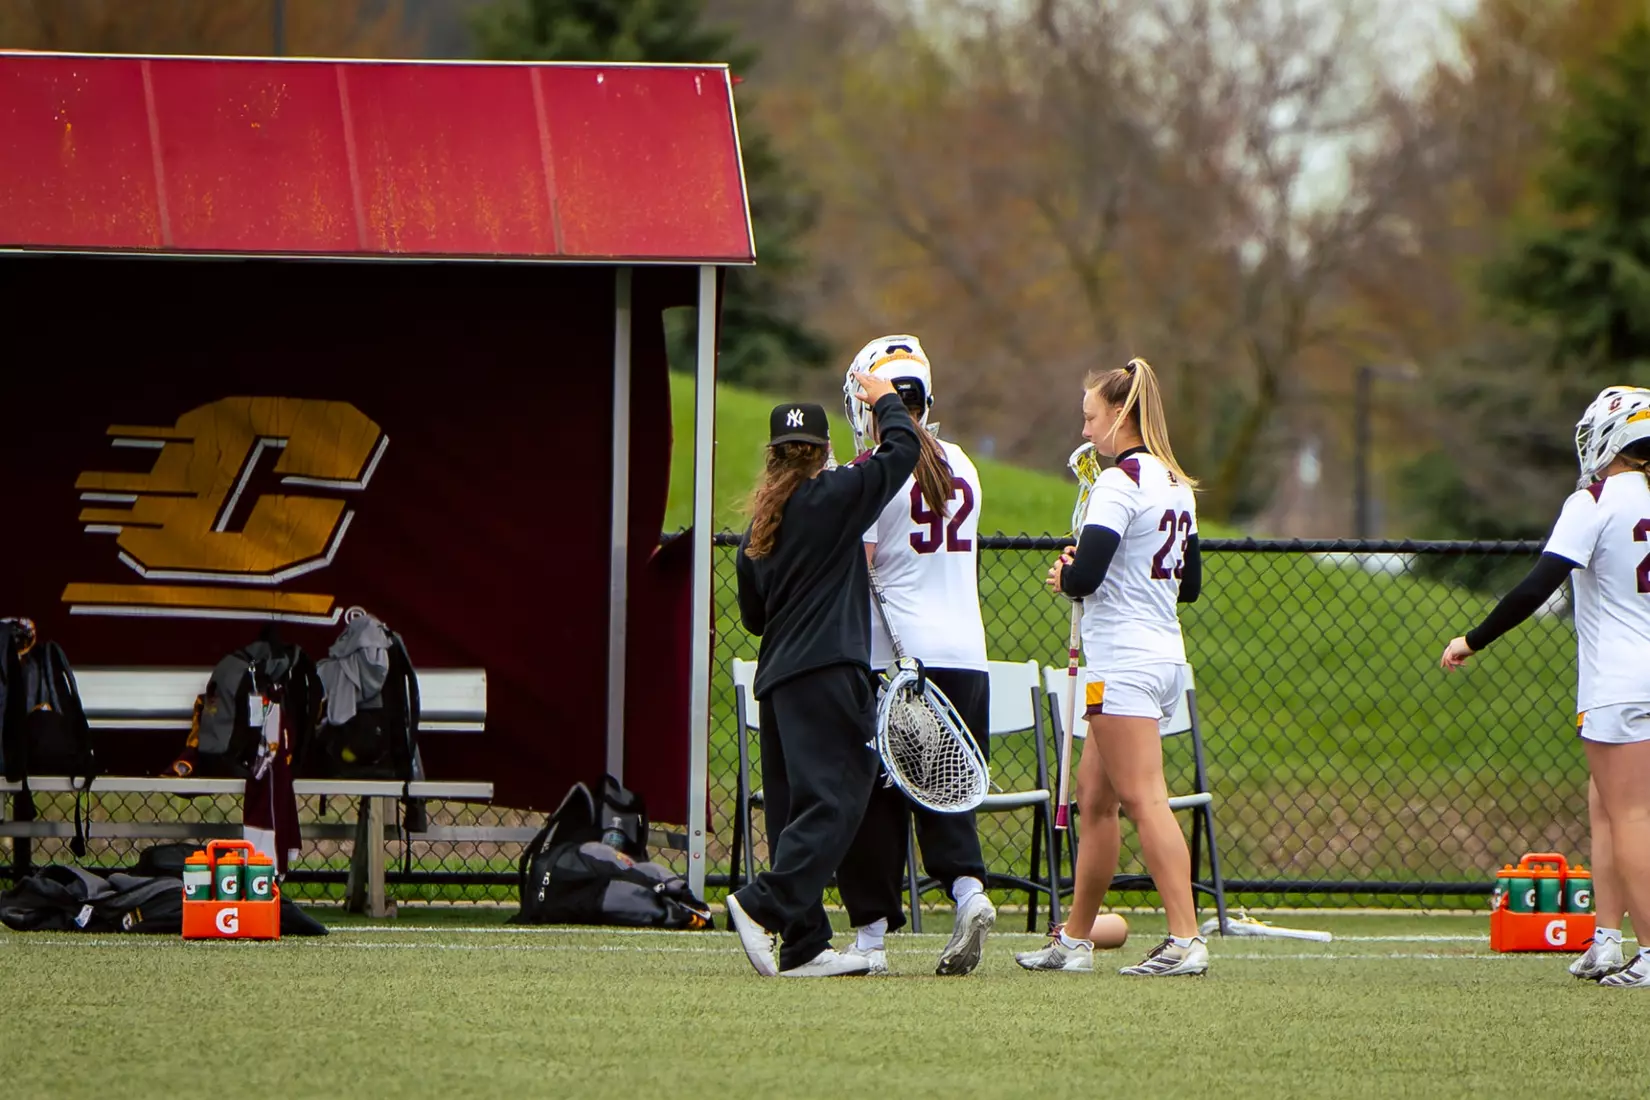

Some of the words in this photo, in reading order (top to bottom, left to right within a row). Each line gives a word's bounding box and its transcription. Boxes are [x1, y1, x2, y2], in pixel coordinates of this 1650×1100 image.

[786, 408, 804, 427] NY
[75, 396, 389, 584] C
[909, 477, 974, 554] 92
[221, 875, 237, 895] G
[252, 876, 268, 895] G
[1574, 889, 1590, 908] G
[215, 907, 239, 934] G
[1545, 920, 1567, 946] G
